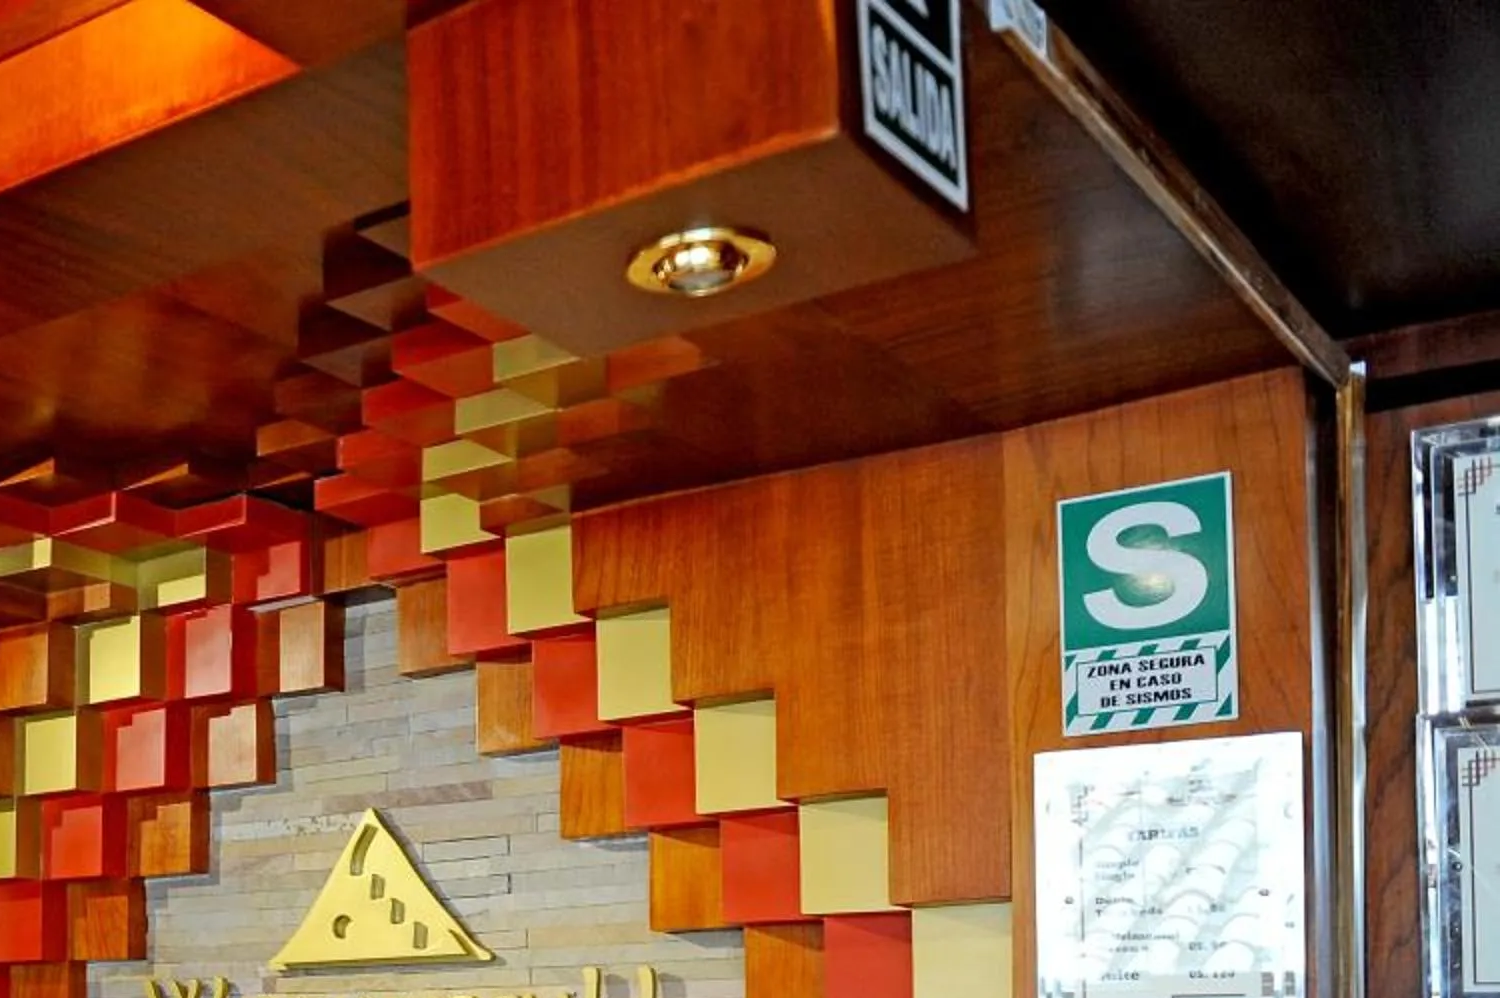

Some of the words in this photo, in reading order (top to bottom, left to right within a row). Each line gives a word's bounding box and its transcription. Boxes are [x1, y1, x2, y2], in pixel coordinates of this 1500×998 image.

[871, 24, 958, 169] SALIDA
[1083, 501, 1209, 630] S
[1086, 662, 1132, 679] ZONA
[1137, 653, 1205, 673] SEGURA
[1109, 678, 1131, 691] EN
[1136, 672, 1182, 688] CASO
[1100, 696, 1120, 709] DE
[1125, 687, 1192, 706] SISMOS
